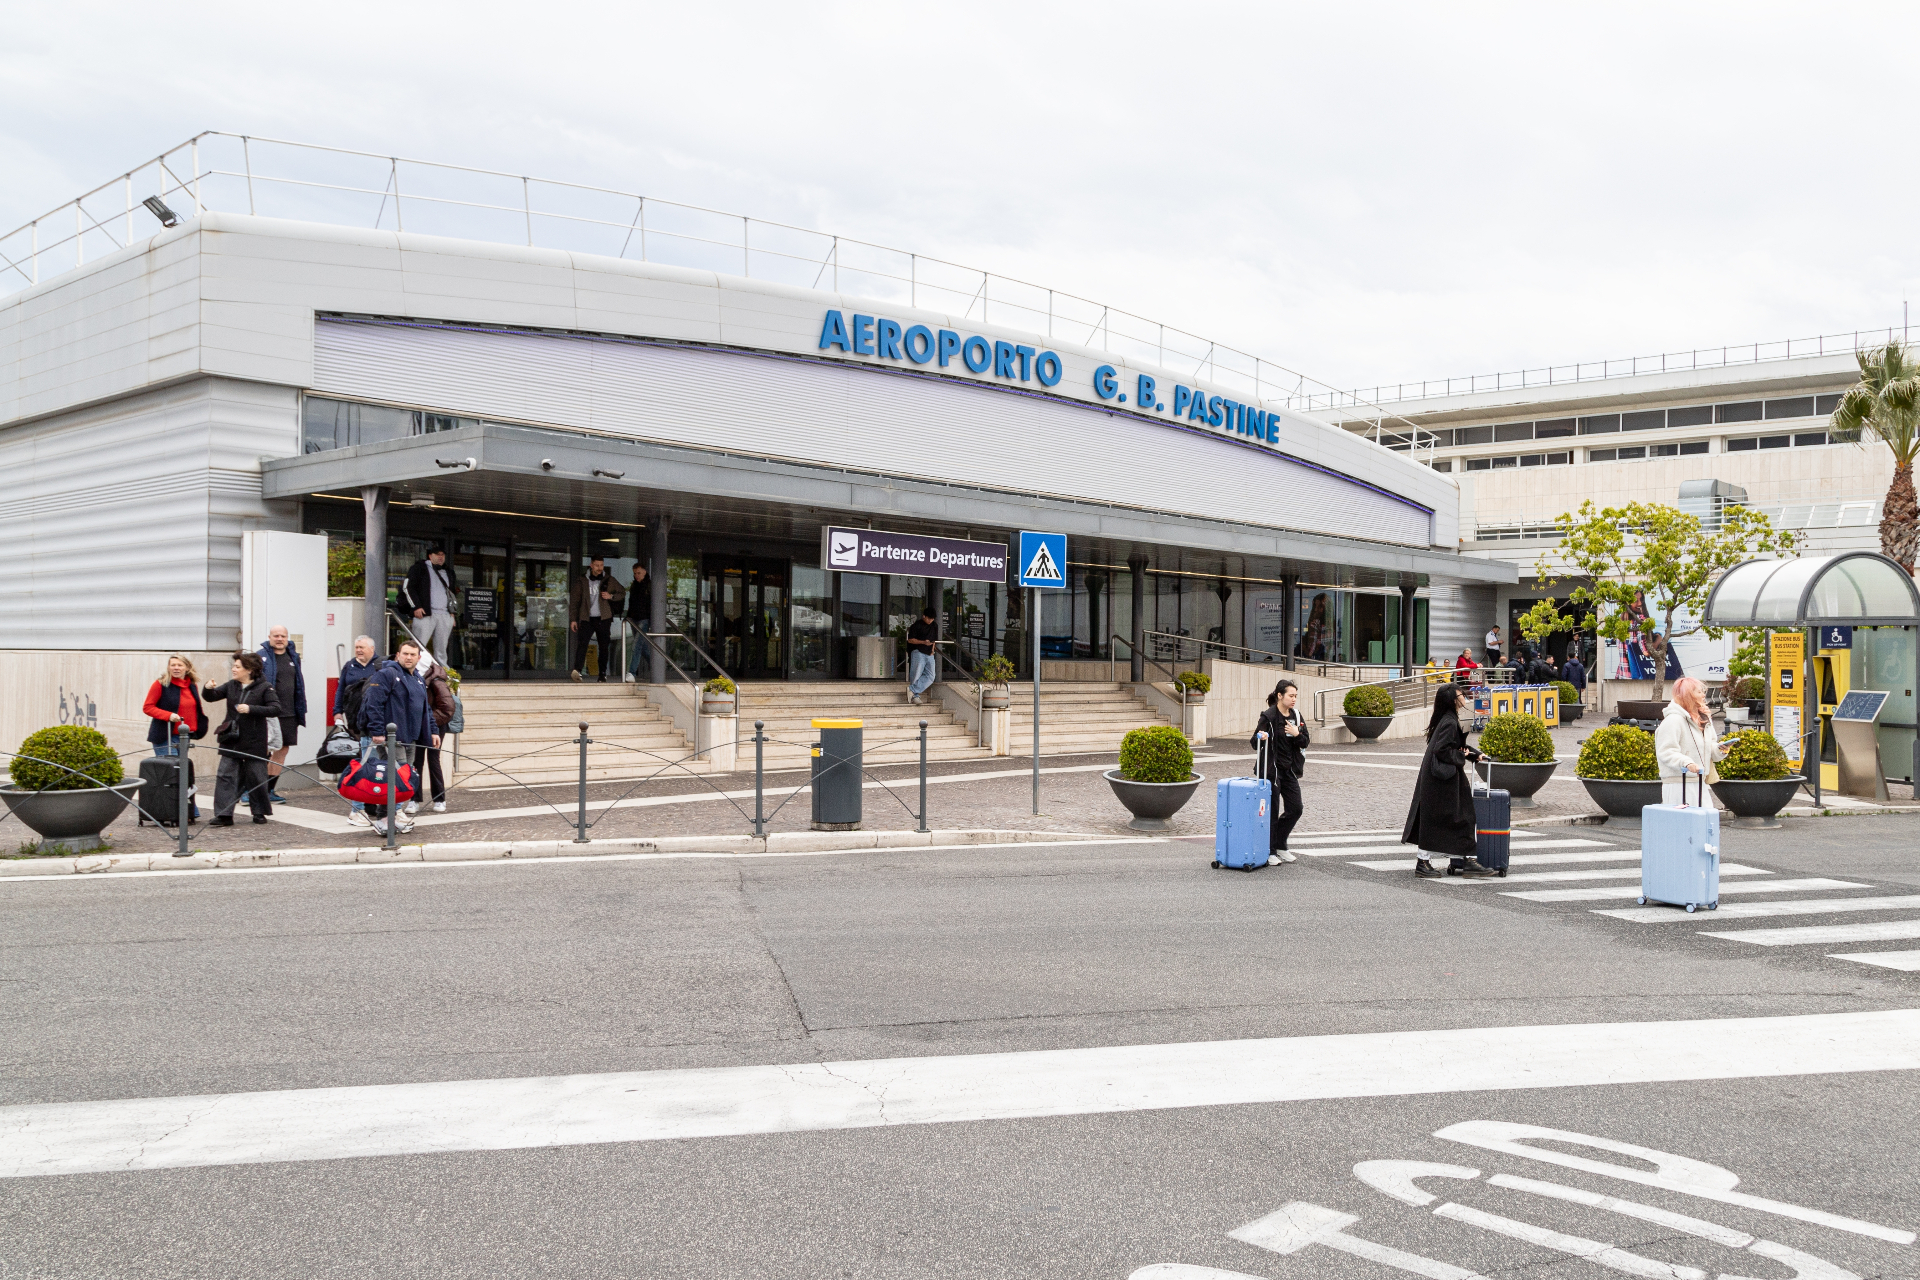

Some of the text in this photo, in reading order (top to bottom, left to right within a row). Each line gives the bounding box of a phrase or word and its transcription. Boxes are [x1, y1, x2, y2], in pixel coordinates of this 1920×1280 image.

[819, 309, 1281, 444] AEROPORTO G. B. PASTINE
[862, 541, 1004, 569] Partenze Departures
